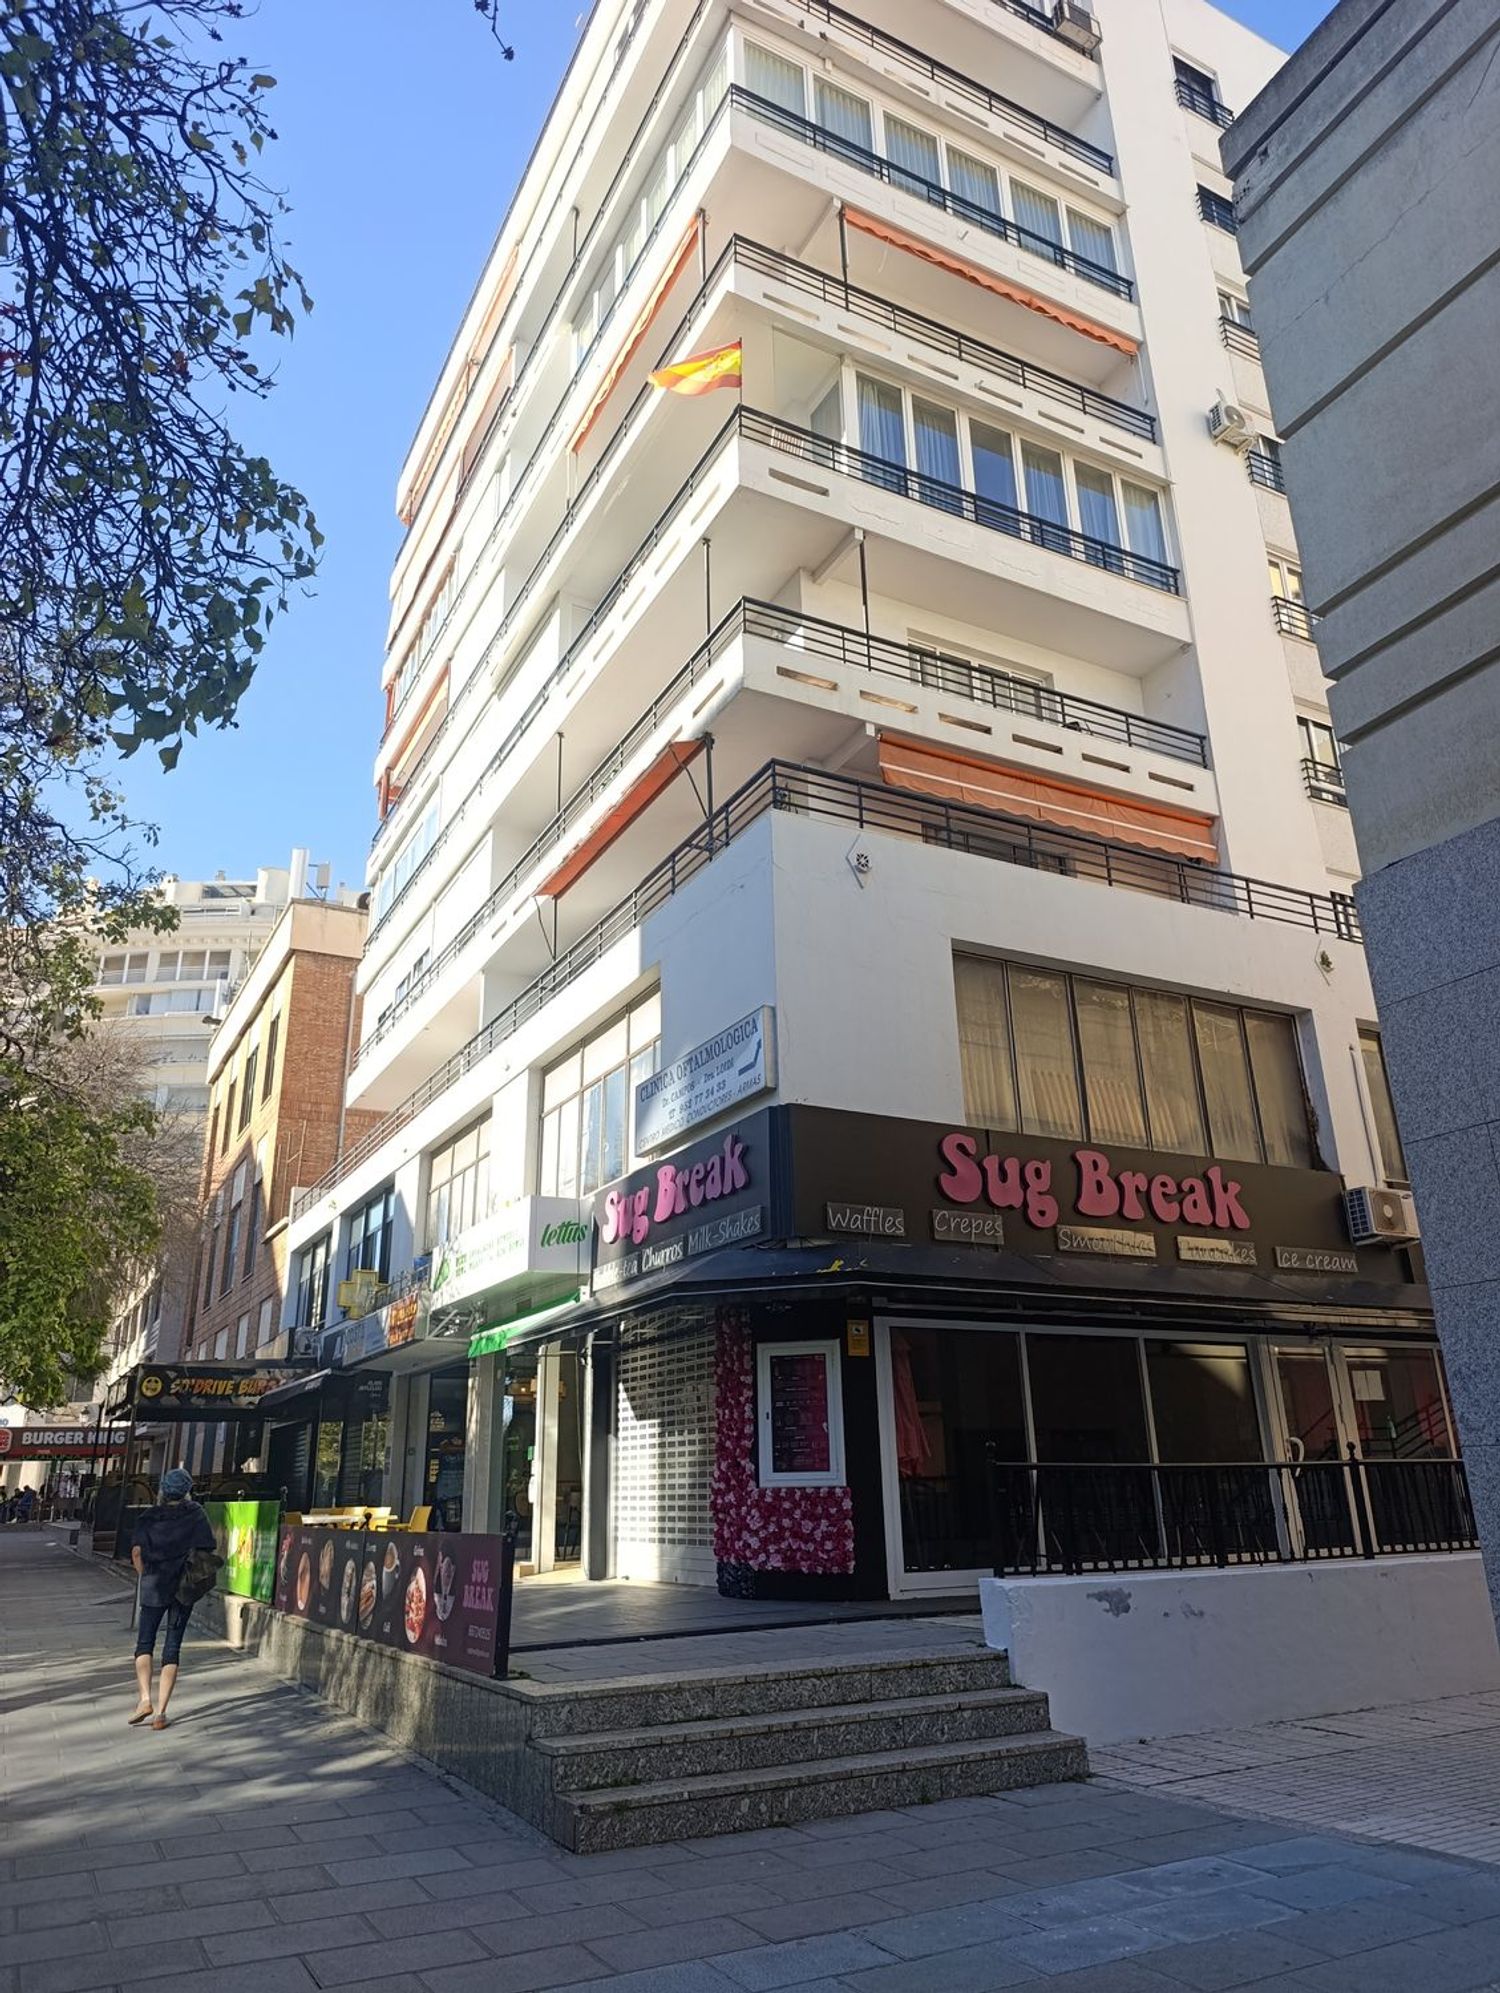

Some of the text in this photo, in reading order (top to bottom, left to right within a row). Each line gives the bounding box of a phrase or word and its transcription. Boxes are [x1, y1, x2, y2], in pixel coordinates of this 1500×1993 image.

[640, 1017, 759, 1103] CLINICA OFTALMOLOGICA
[737, 1074, 762, 1095] ARMAS
[602, 1133, 749, 1245] Sug Break
[938, 1132, 1250, 1229] Sug Break
[541, 1220, 588, 1248] lettus
[687, 1212, 761, 1251] Milk-Shakes
[828, 1206, 905, 1234] Waffles
[935, 1211, 1002, 1239] Crepes
[641, 1240, 684, 1272] Churros
[1278, 1249, 1357, 1271] Ice cream
[22, 1431, 85, 1445] BURGER
[472, 1559, 489, 1583] SUG
[462, 1585, 494, 1611] BREAK
